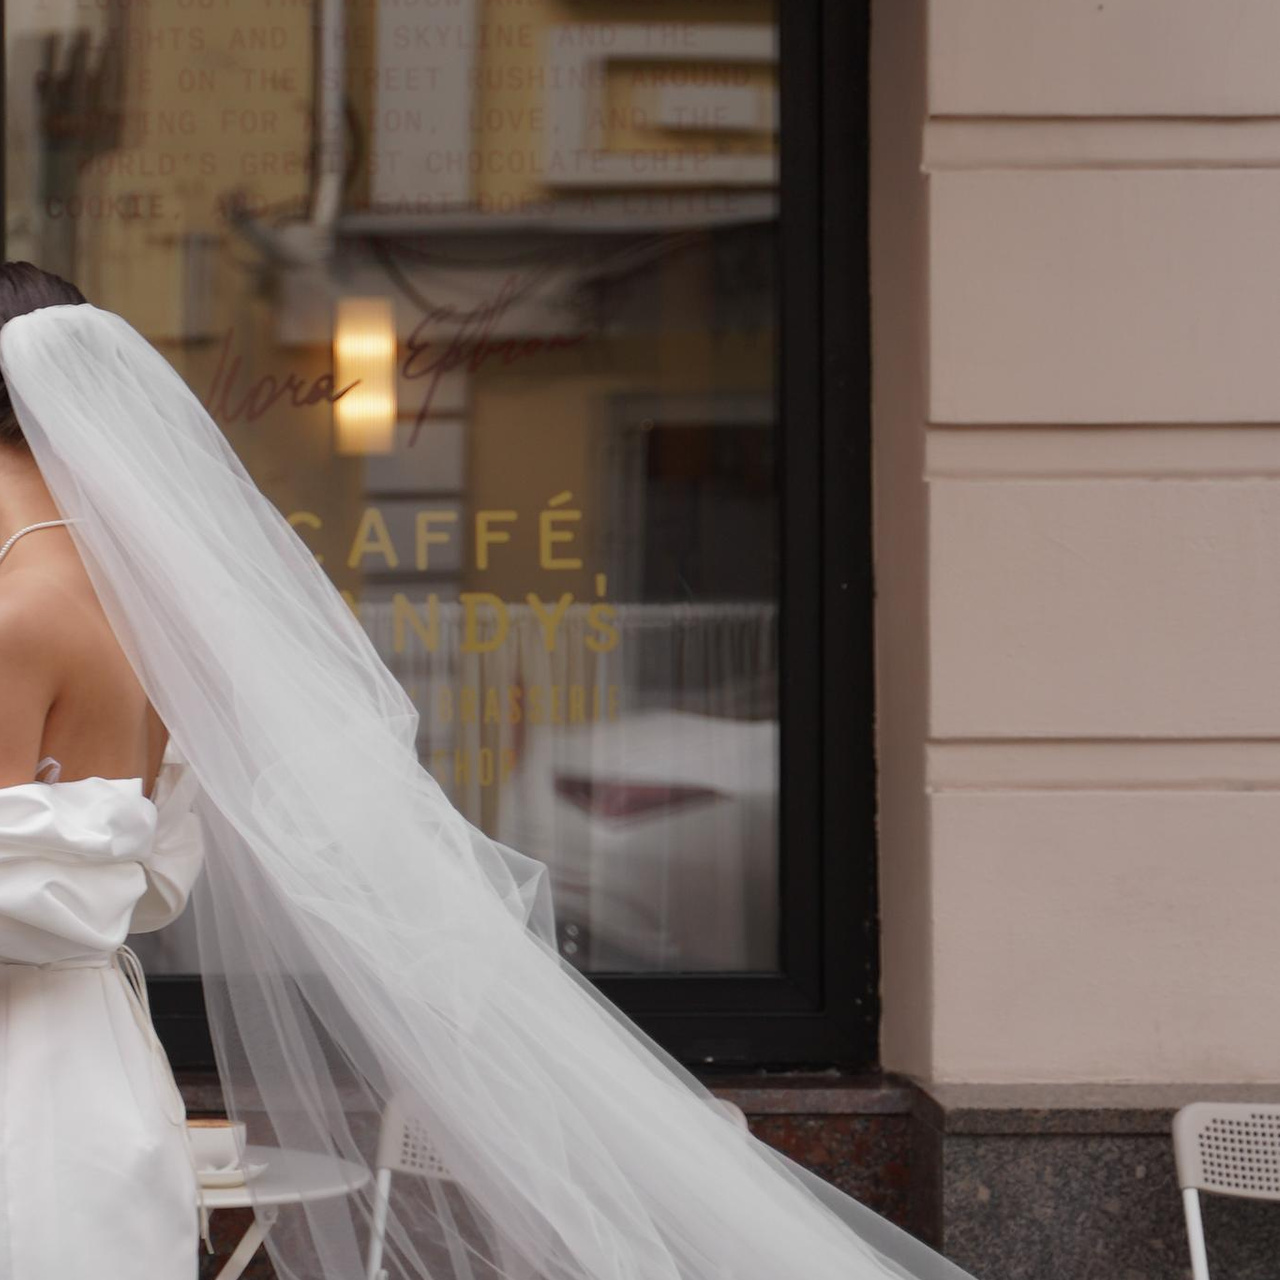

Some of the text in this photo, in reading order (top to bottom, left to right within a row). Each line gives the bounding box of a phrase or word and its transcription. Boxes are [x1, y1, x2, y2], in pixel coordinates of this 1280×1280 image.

[229, 26, 287, 51] AND
[393, 24, 534, 49] SKYLINE
[557, 23, 617, 47] AND
[642, 23, 698, 47] THE
[178, 68, 216, 92] ON
[242, 68, 297, 92] THE
[220, 109, 278, 134] FOR
[426, 150, 606, 175] CHOCOLATE
[437, 684, 621, 725] BRASSERIE
